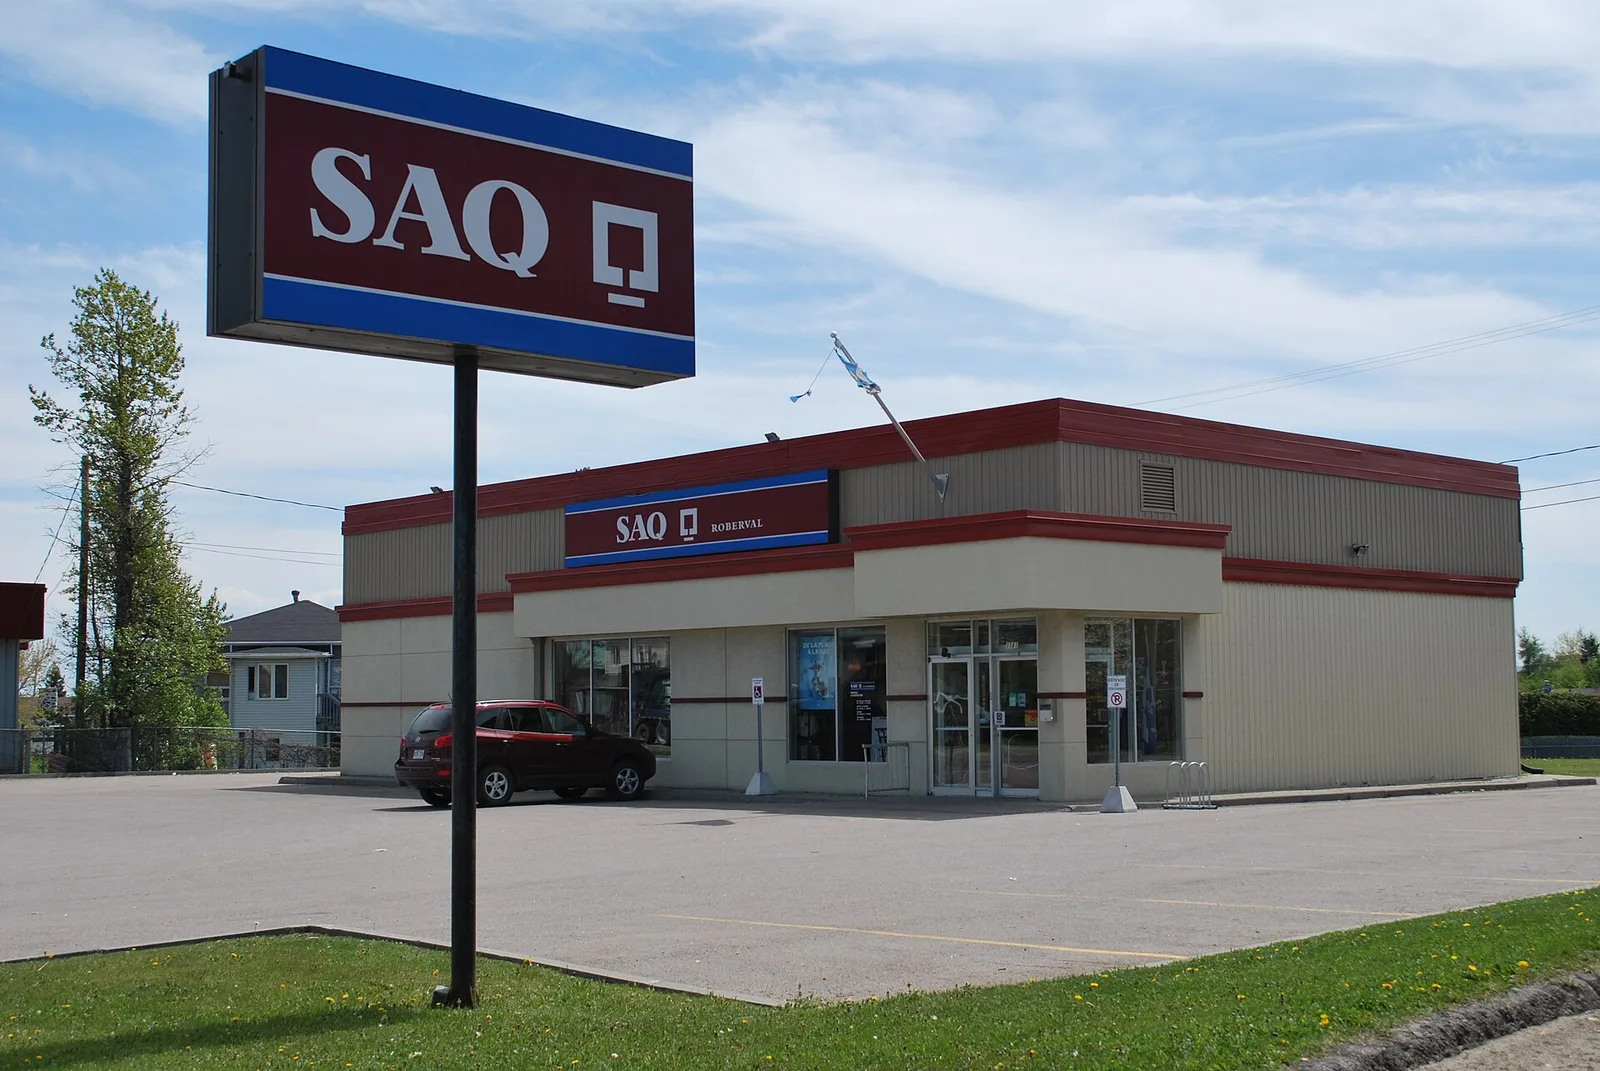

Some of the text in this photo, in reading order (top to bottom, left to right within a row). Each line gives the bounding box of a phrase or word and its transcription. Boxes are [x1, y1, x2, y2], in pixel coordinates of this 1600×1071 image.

[309, 147, 549, 278] SAQ
[616, 511, 764, 543] SAQ ROBERVAL
